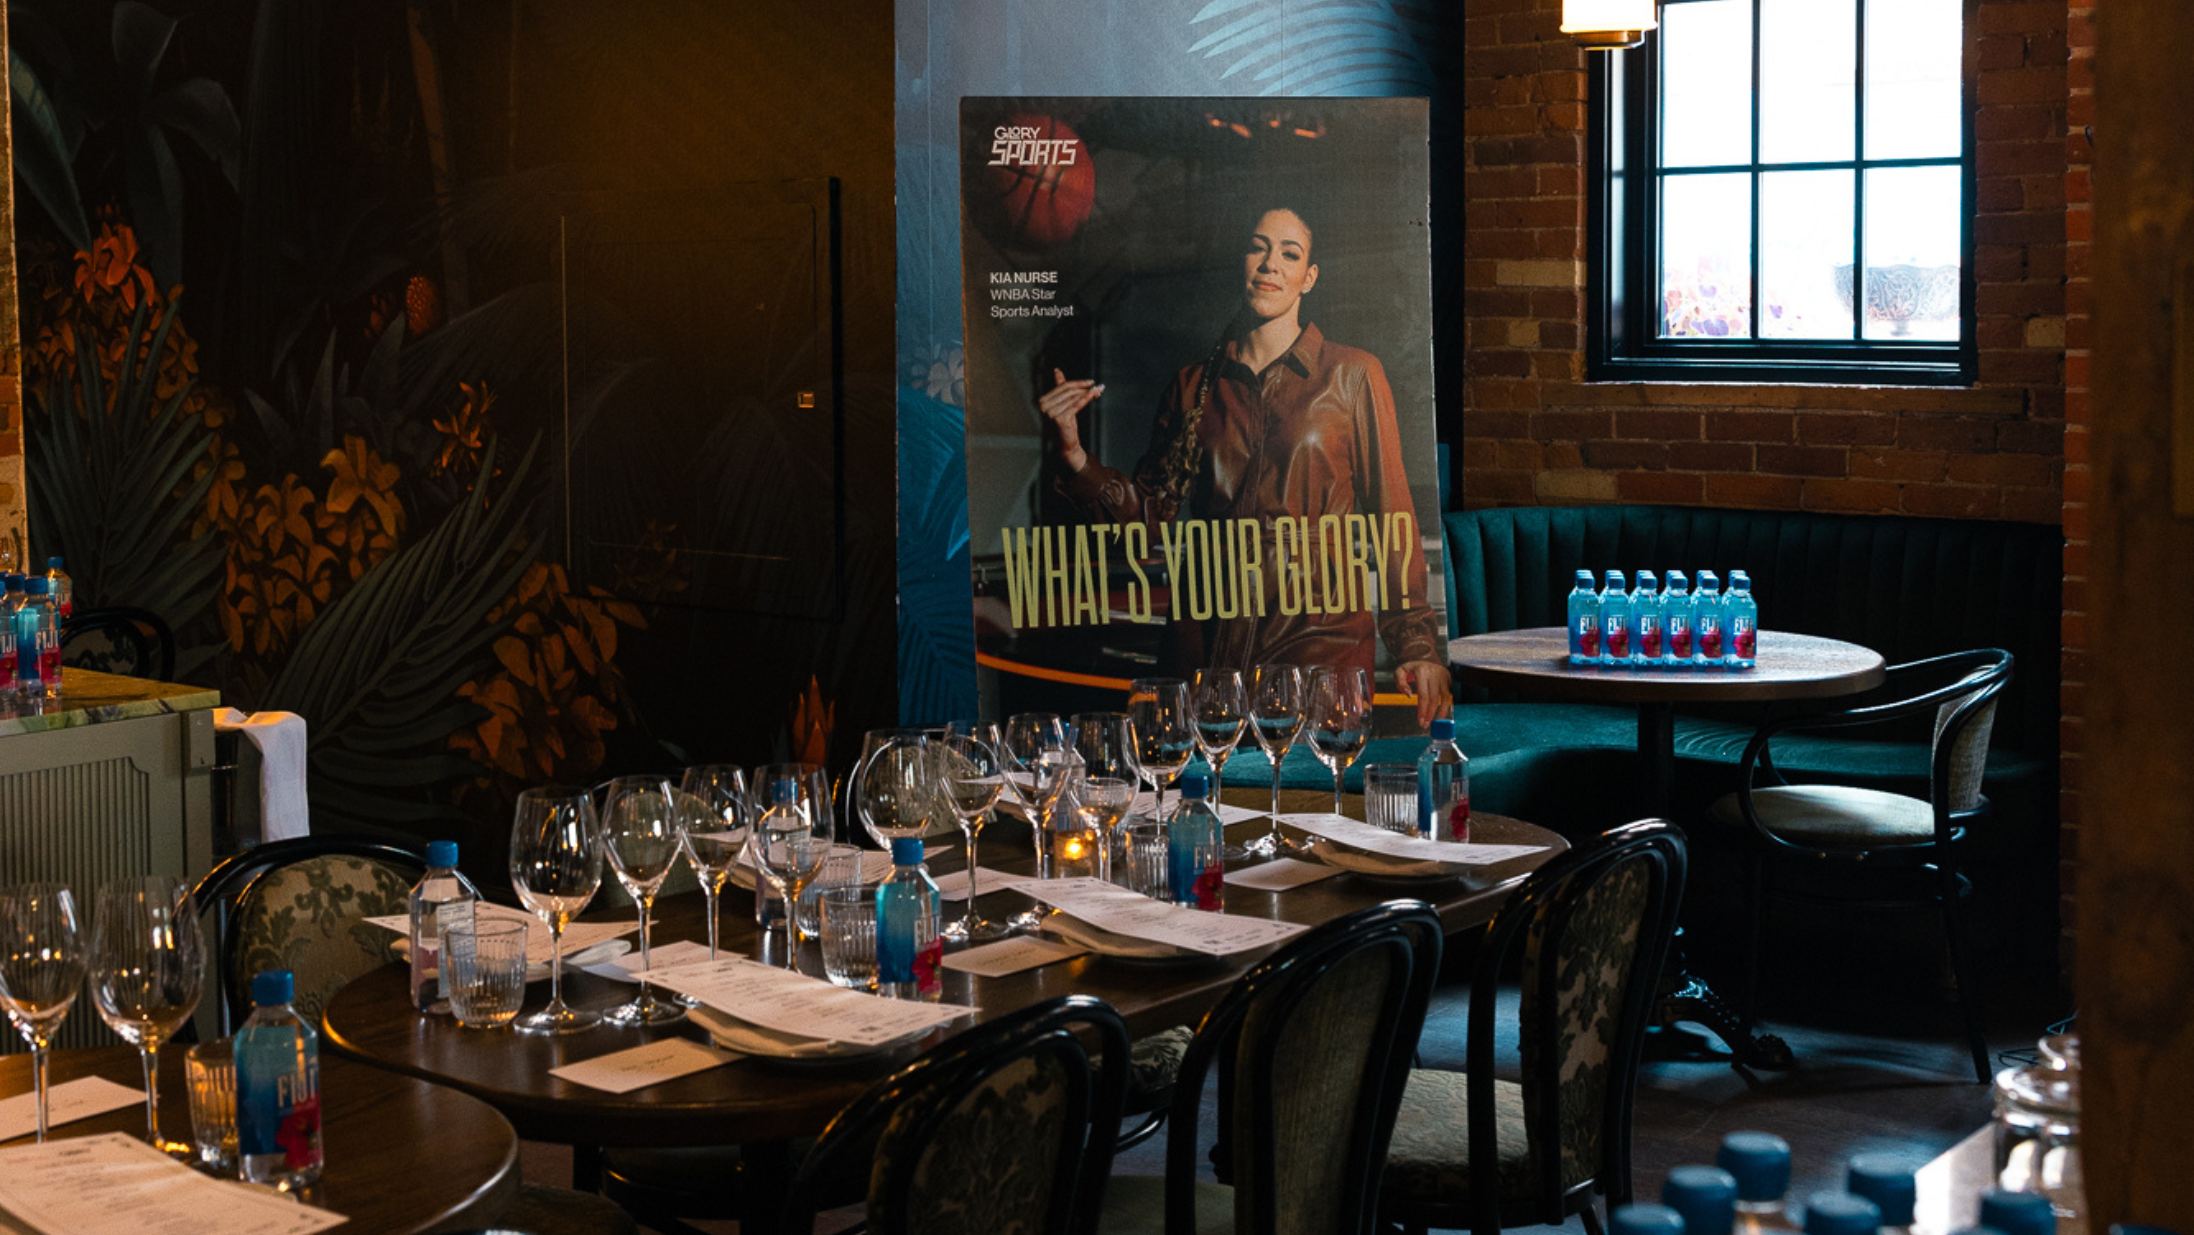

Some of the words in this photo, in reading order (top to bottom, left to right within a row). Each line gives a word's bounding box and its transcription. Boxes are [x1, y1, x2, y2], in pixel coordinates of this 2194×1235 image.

[994, 125, 1041, 140] GLORY
[987, 139, 1079, 165] SPORTS
[990, 272, 1012, 284] KIA
[1014, 271, 1059, 284] NURSE
[990, 288, 1030, 301] WNBA
[1031, 287, 1056, 300] Star
[990, 305, 1030, 319] Sports
[1031, 304, 1074, 319] Analyst
[1001, 521, 1152, 629] WHAT'S
[1160, 517, 1266, 621] YOUR
[1275, 511, 1413, 616] GLORY?
